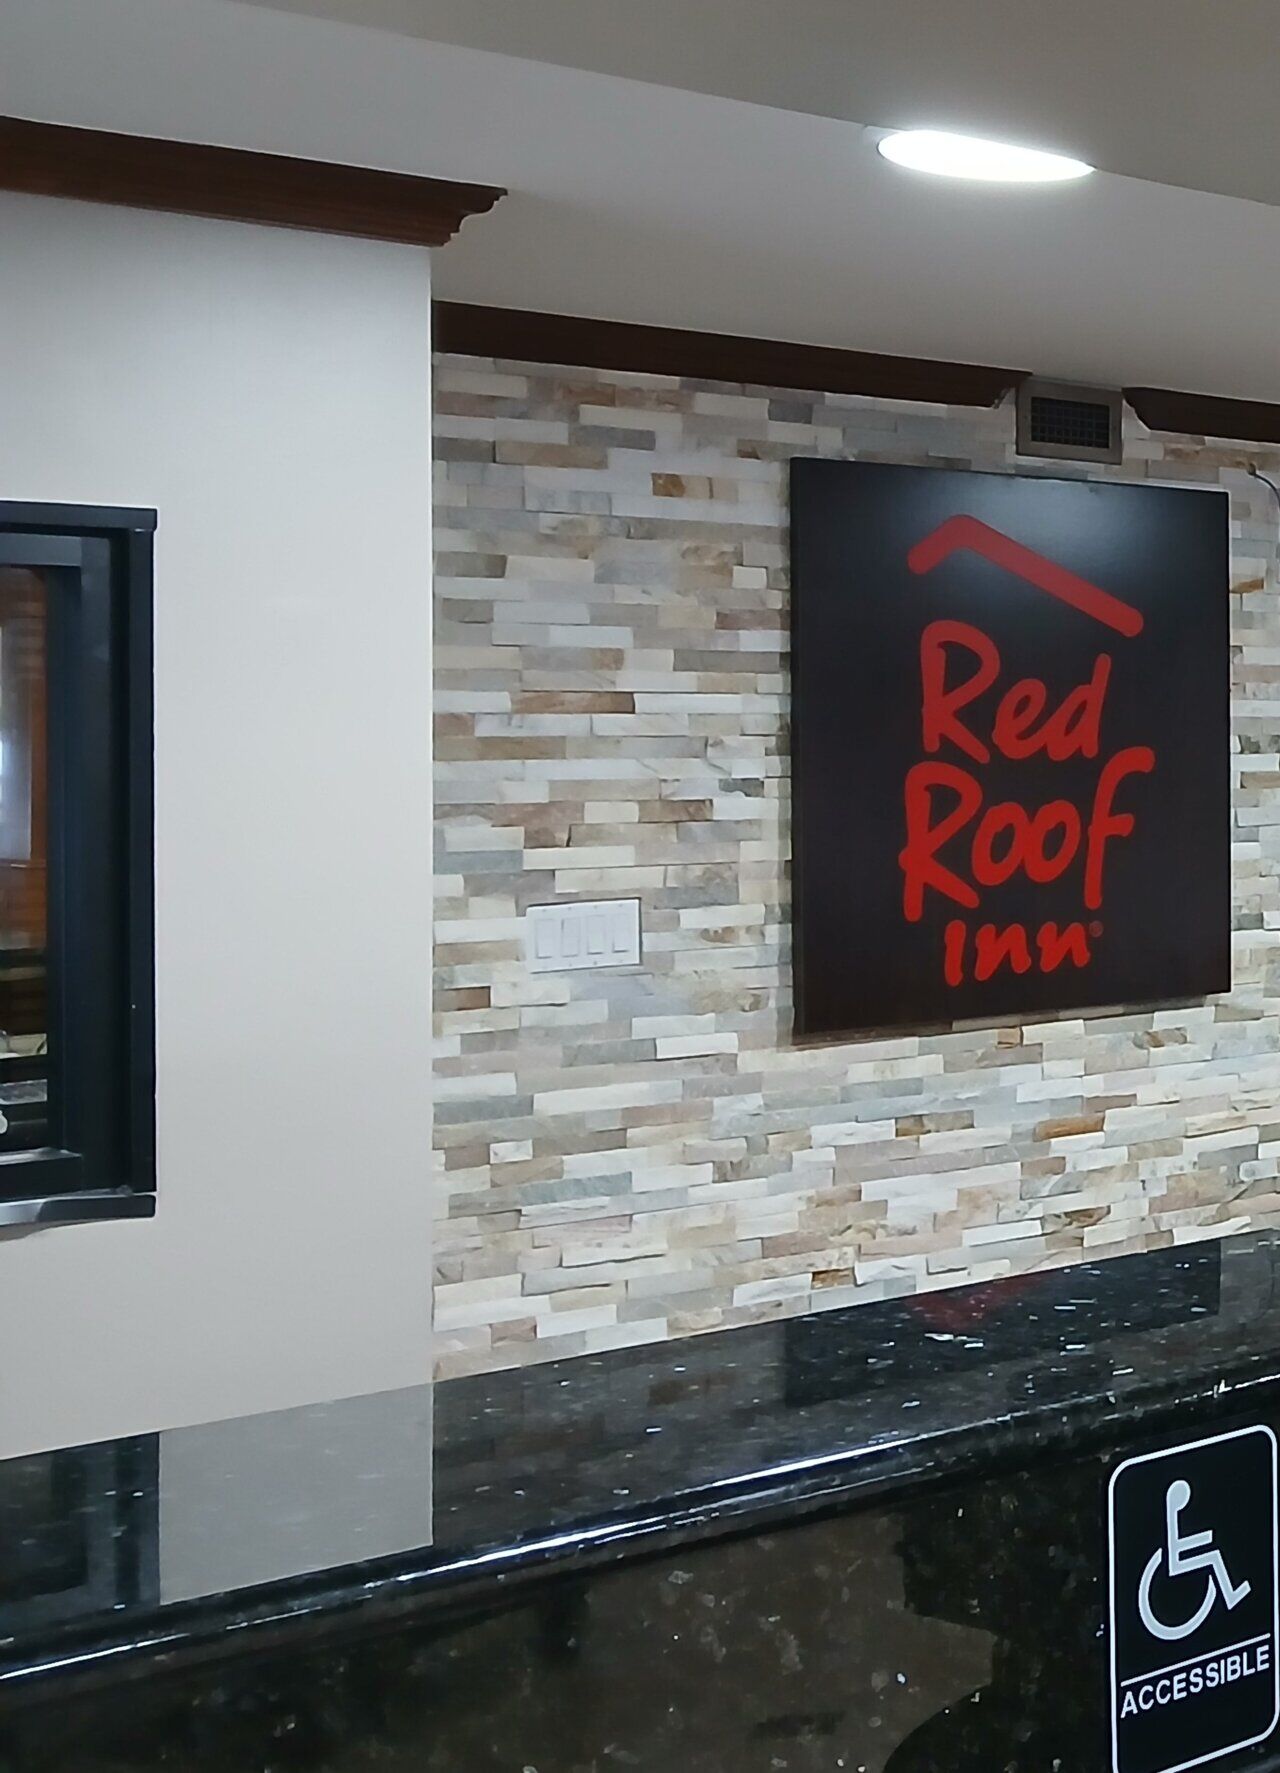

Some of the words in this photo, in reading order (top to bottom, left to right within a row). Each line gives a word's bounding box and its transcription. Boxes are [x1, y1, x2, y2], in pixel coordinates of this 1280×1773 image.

[920, 619, 1112, 764] Red
[898, 746, 1155, 922] Roof
[1120, 1644, 1270, 1719] ACCESSIBLE
